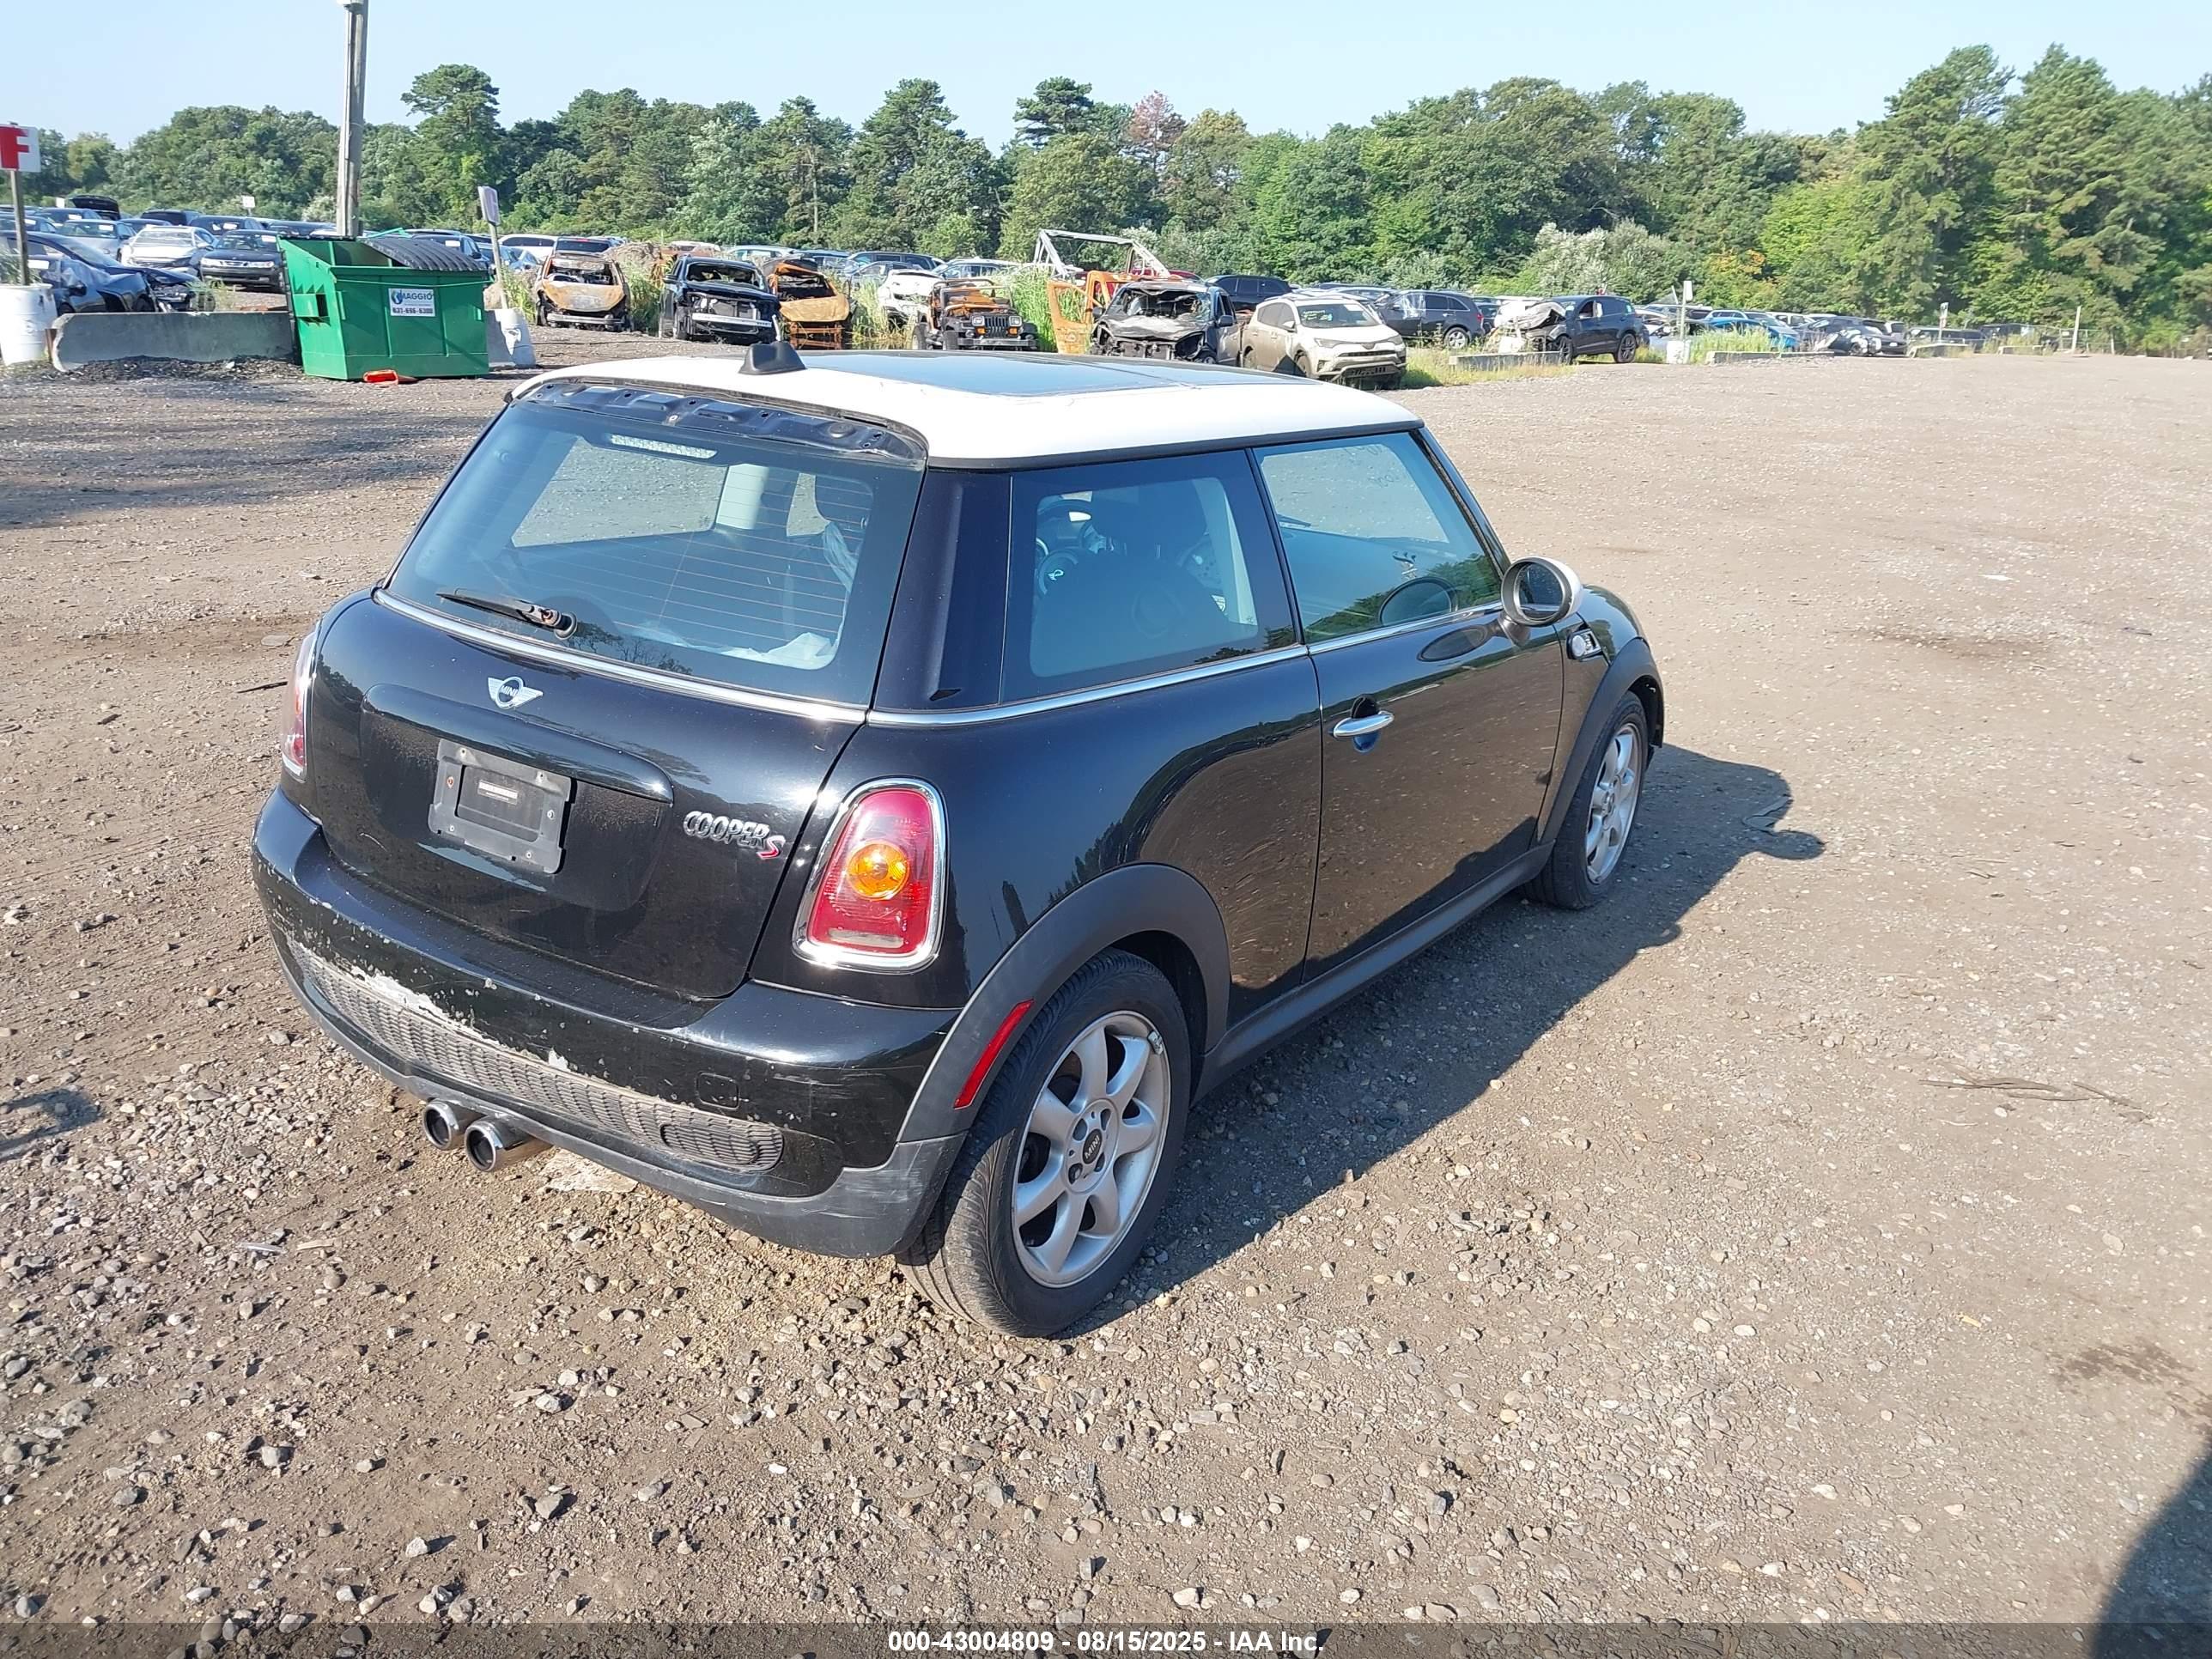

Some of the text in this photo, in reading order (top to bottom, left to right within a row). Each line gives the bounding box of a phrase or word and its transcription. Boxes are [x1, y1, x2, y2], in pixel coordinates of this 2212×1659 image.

[0, 126, 29, 169] F
[500, 685, 519, 697] MINI
[683, 811, 786, 860] COOPER S
[1085, 1134, 1100, 1159] MINI
